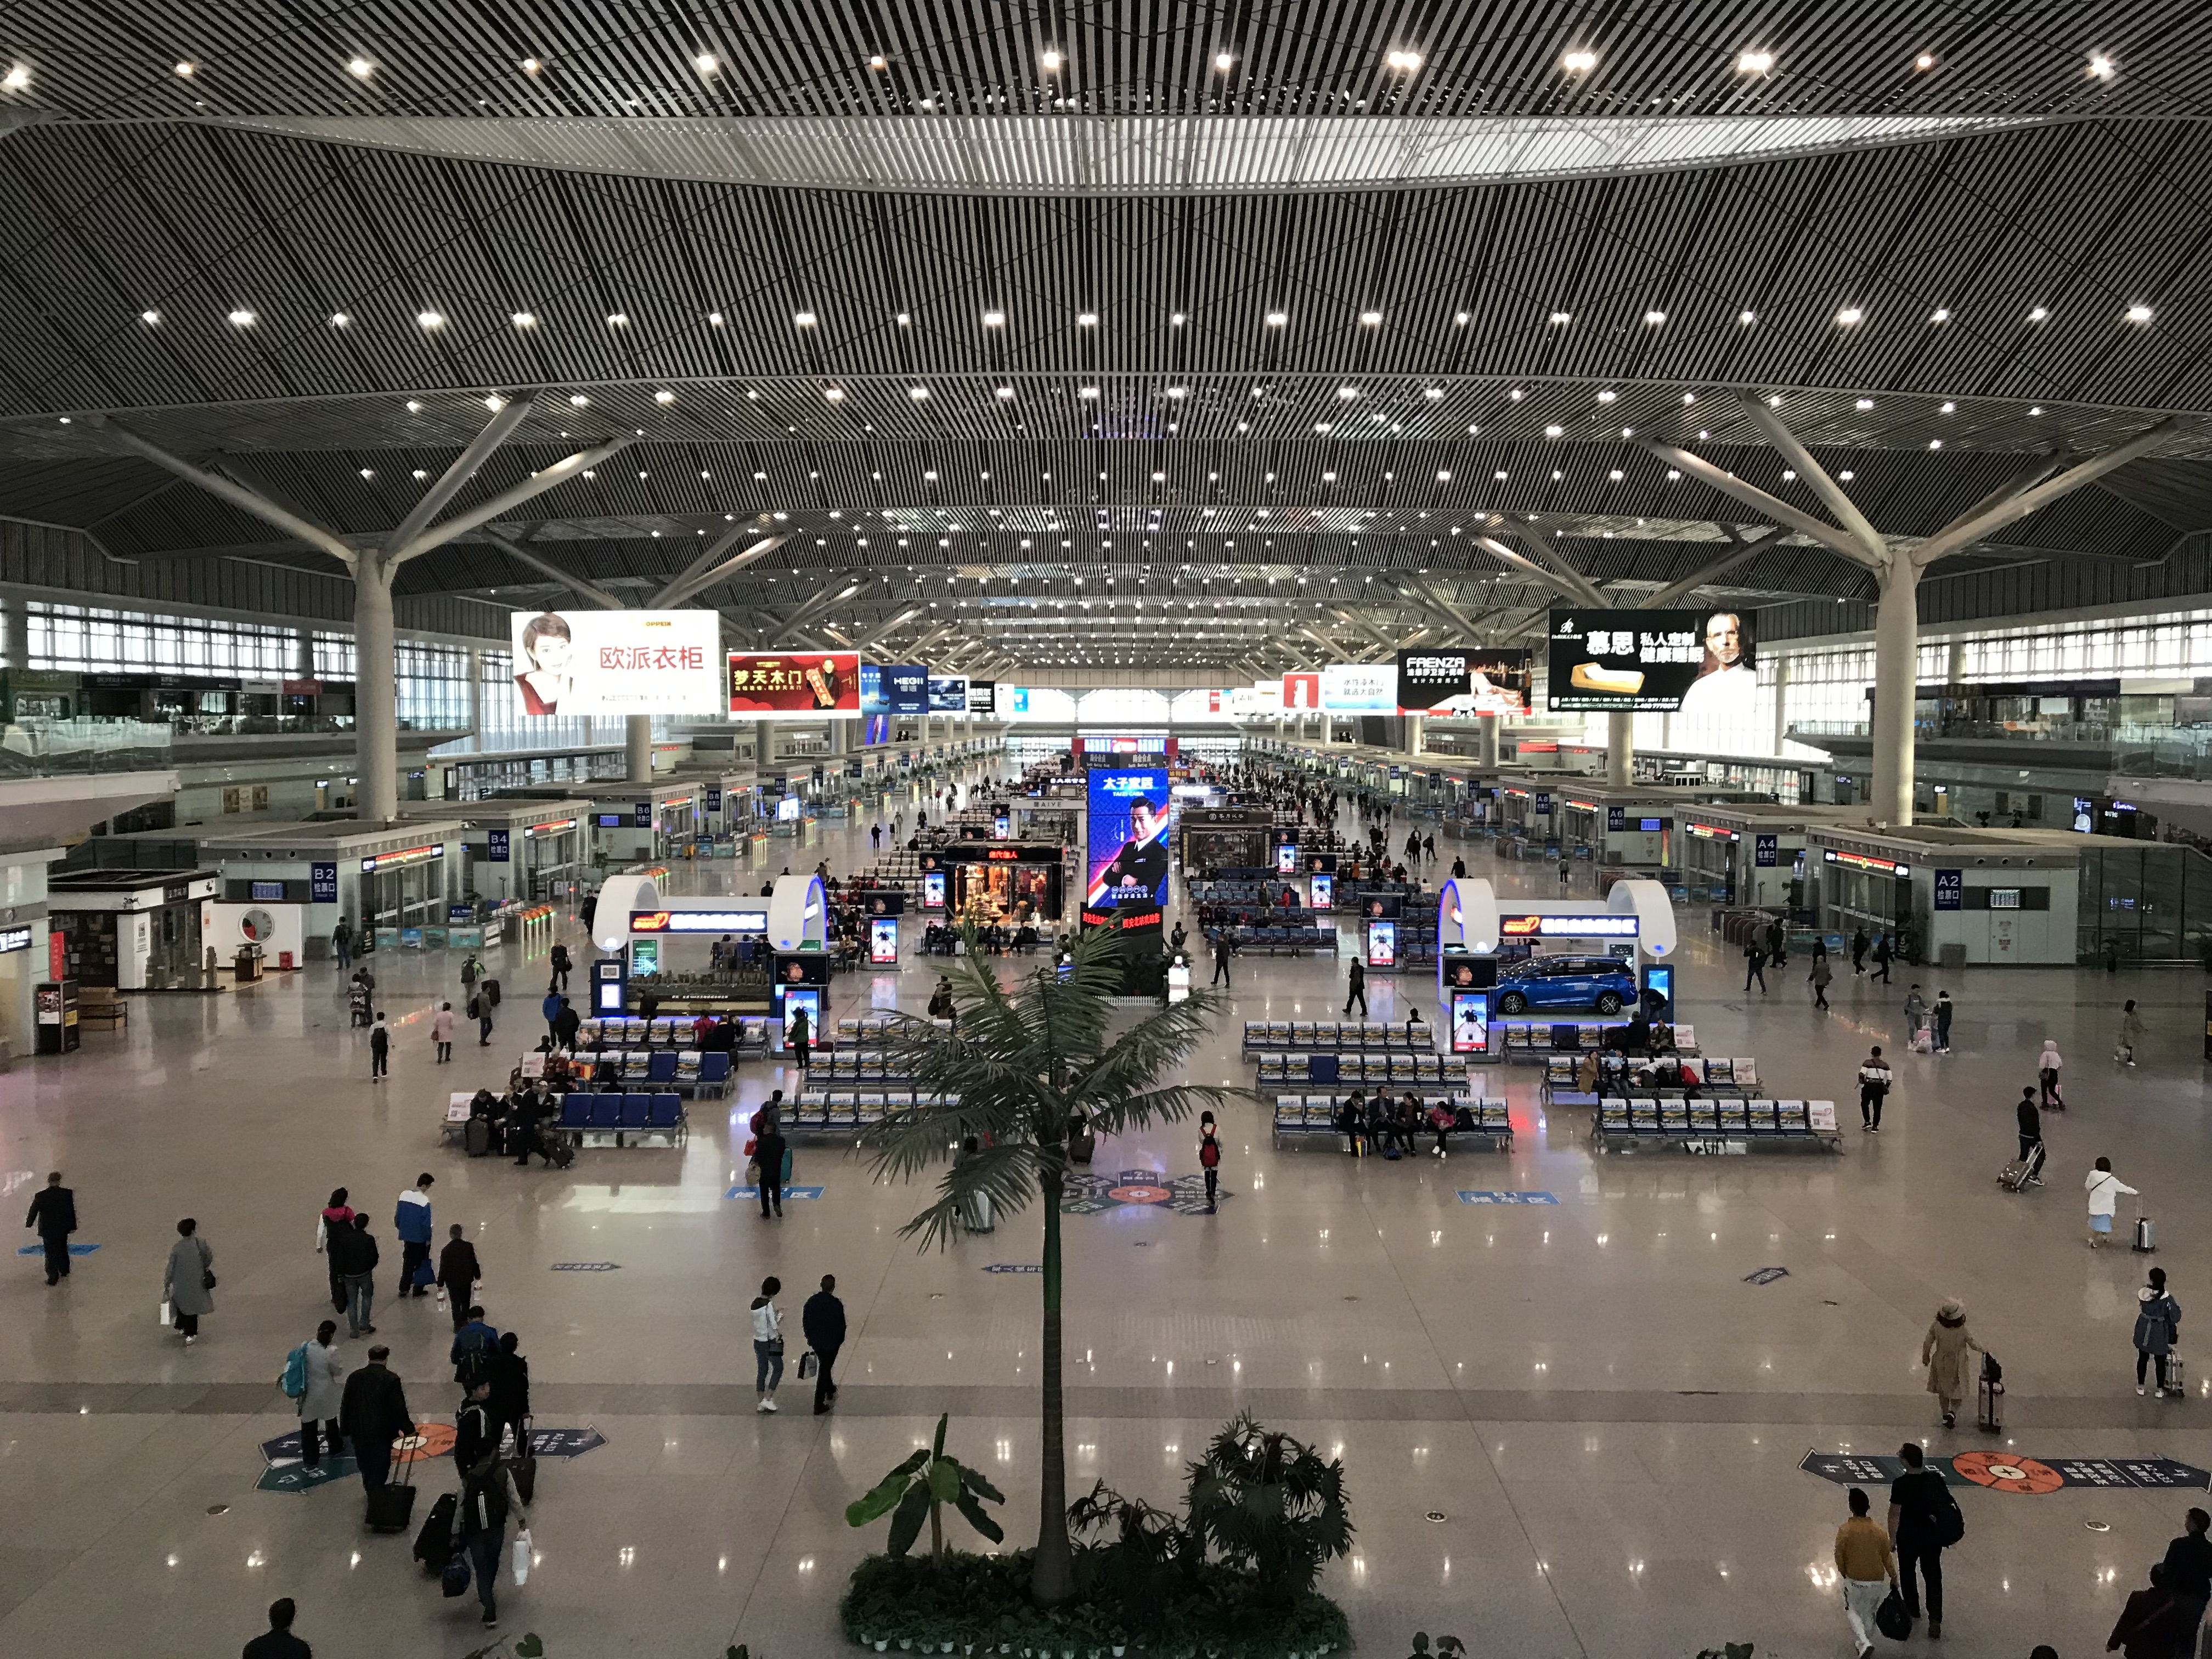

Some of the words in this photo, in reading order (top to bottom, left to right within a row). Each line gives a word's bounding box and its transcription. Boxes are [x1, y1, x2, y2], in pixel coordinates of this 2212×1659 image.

[1587, 631, 1635, 655] 慕思
[1640, 631, 1696, 646] 私人定制
[600, 645, 704, 670] 欧派衣柜
[1639, 646, 1705, 663] 健康睡眠
[1407, 657, 1465, 668] FAENZA
[733, 670, 802, 685] 梦天木门
[894, 677, 924, 685] HEGII
[1103, 777, 1154, 790] 太子家居
[1758, 839, 1774, 848] A4
[314, 868, 334, 879] B2
[1938, 876, 1959, 887] A2
